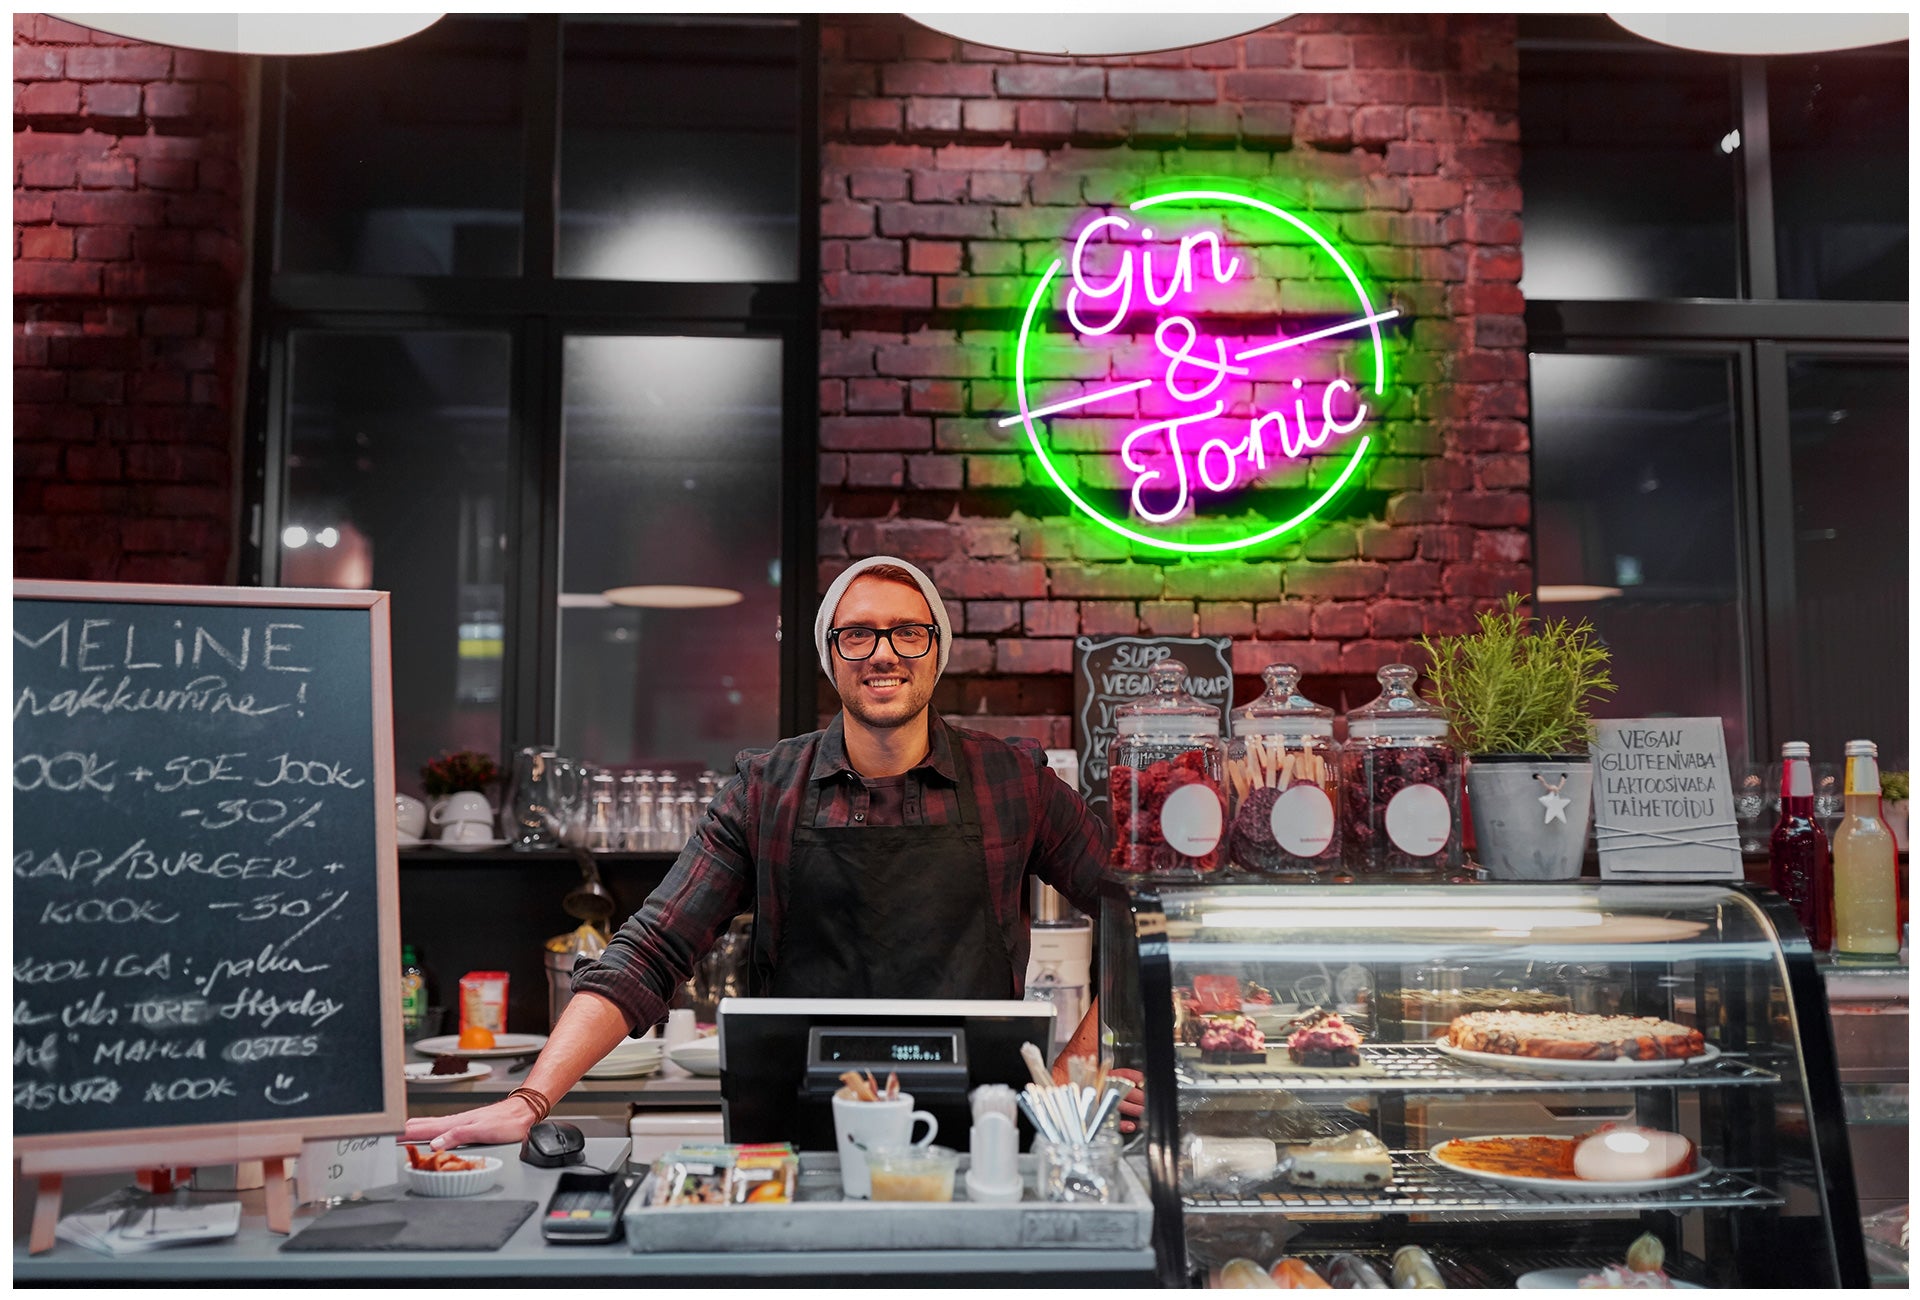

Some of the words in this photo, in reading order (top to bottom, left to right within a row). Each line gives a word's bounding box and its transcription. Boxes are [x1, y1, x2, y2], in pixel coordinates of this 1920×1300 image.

[1067, 215, 1240, 337] Gin
[1155, 315, 1249, 402] &
[1121, 378, 1368, 523] Tonic
[1112, 644, 1172, 667] SUPP
[1101, 672, 1152, 696] VEGA
[1618, 730, 1683, 749] VEGAN
[154, 752, 249, 792] SOE
[254, 752, 366, 789] JOOK
[1602, 750, 1716, 771] GLUTEENIVABA
[1608, 775, 1716, 795] LAKTOOSIVABA
[1608, 796, 1714, 819] TAIMETOIDU
[180, 797, 324, 846] -30%
[39, 897, 180, 924] KOOK
[124, 999, 206, 1025] TORE
[229, 1034, 319, 1061] OSTES
[14, 1076, 122, 1109] ASUTA
